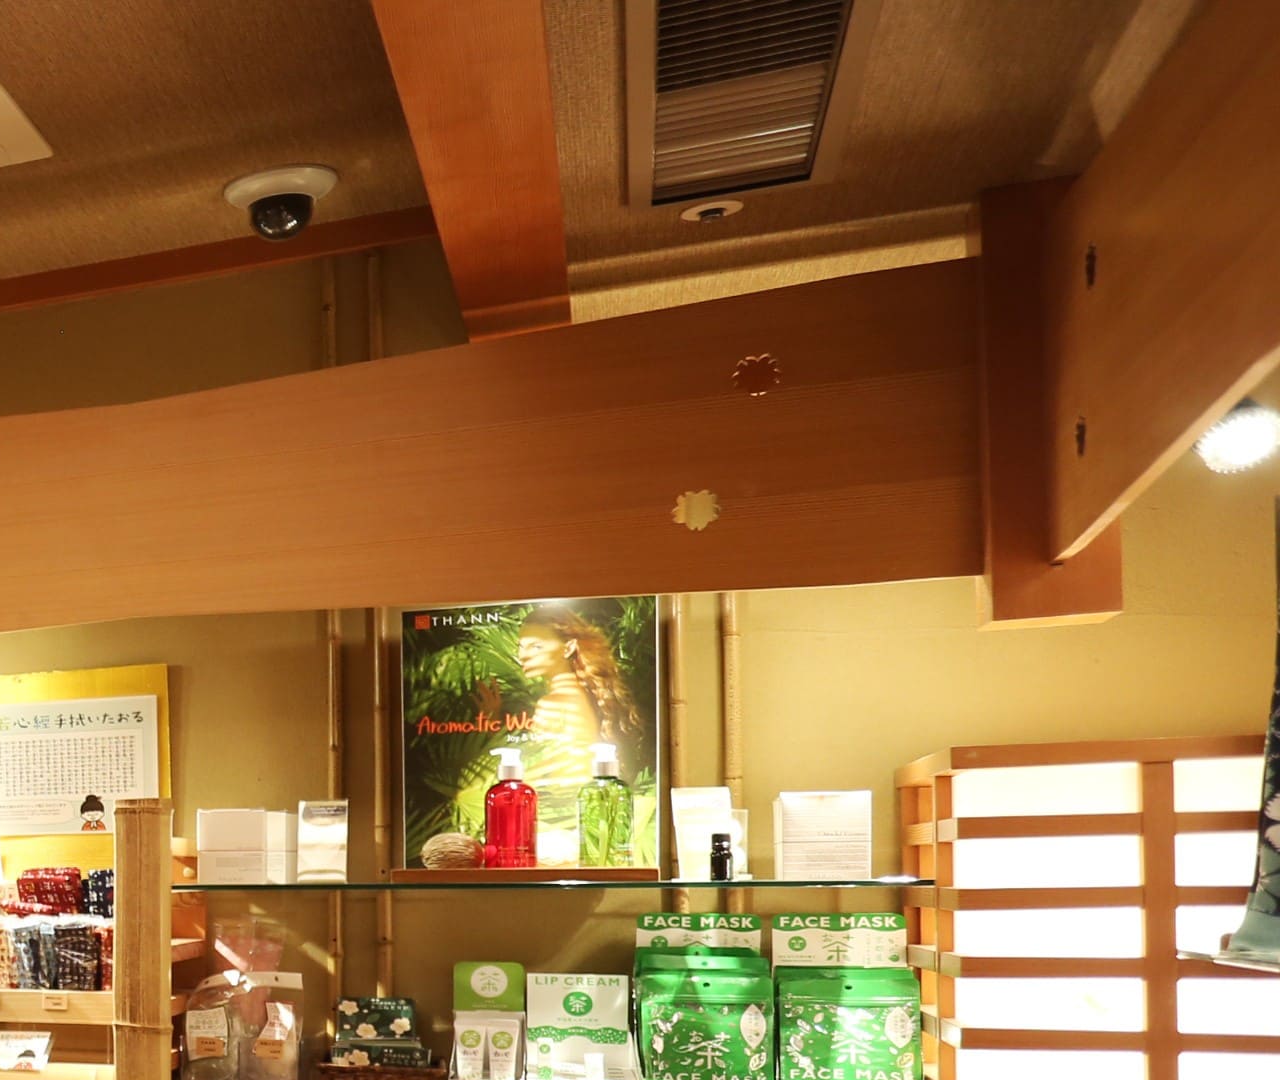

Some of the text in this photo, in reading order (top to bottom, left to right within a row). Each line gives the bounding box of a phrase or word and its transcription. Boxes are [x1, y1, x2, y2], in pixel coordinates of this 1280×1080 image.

[432, 611, 501, 627] THANN
[417, 711, 501, 736] Aromatic
[643, 916, 754, 928] FACE MASK
[779, 916, 899, 928] FACE MASK
[535, 976, 620, 987] LIP CREAM
[790, 1068, 845, 1080] FACE
